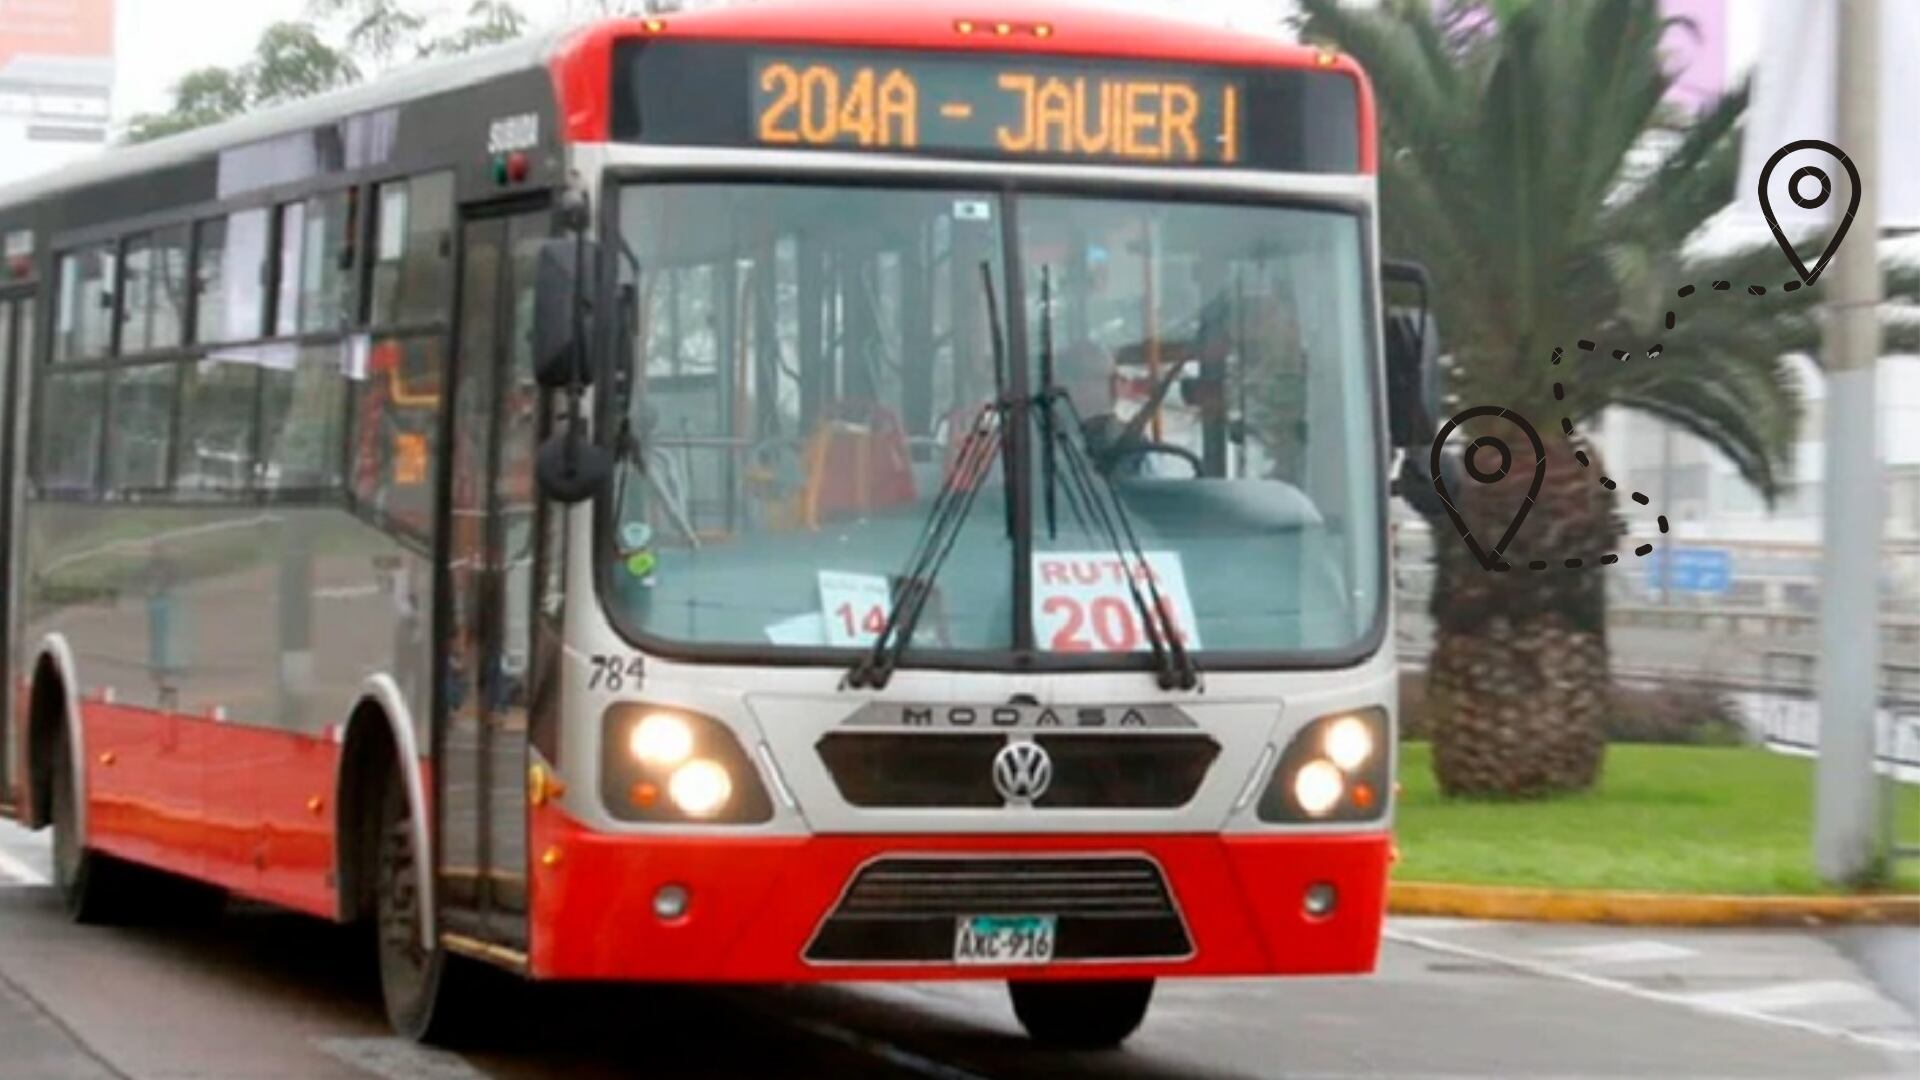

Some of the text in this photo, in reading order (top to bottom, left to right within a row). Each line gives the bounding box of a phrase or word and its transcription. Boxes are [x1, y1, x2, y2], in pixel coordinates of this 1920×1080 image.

[760, 63, 918, 146] 204A
[998, 72, 1199, 160] JAVIER
[1041, 560, 1160, 586] RUTA
[589, 655, 645, 691] 784
[902, 707, 1146, 726] MODASA
